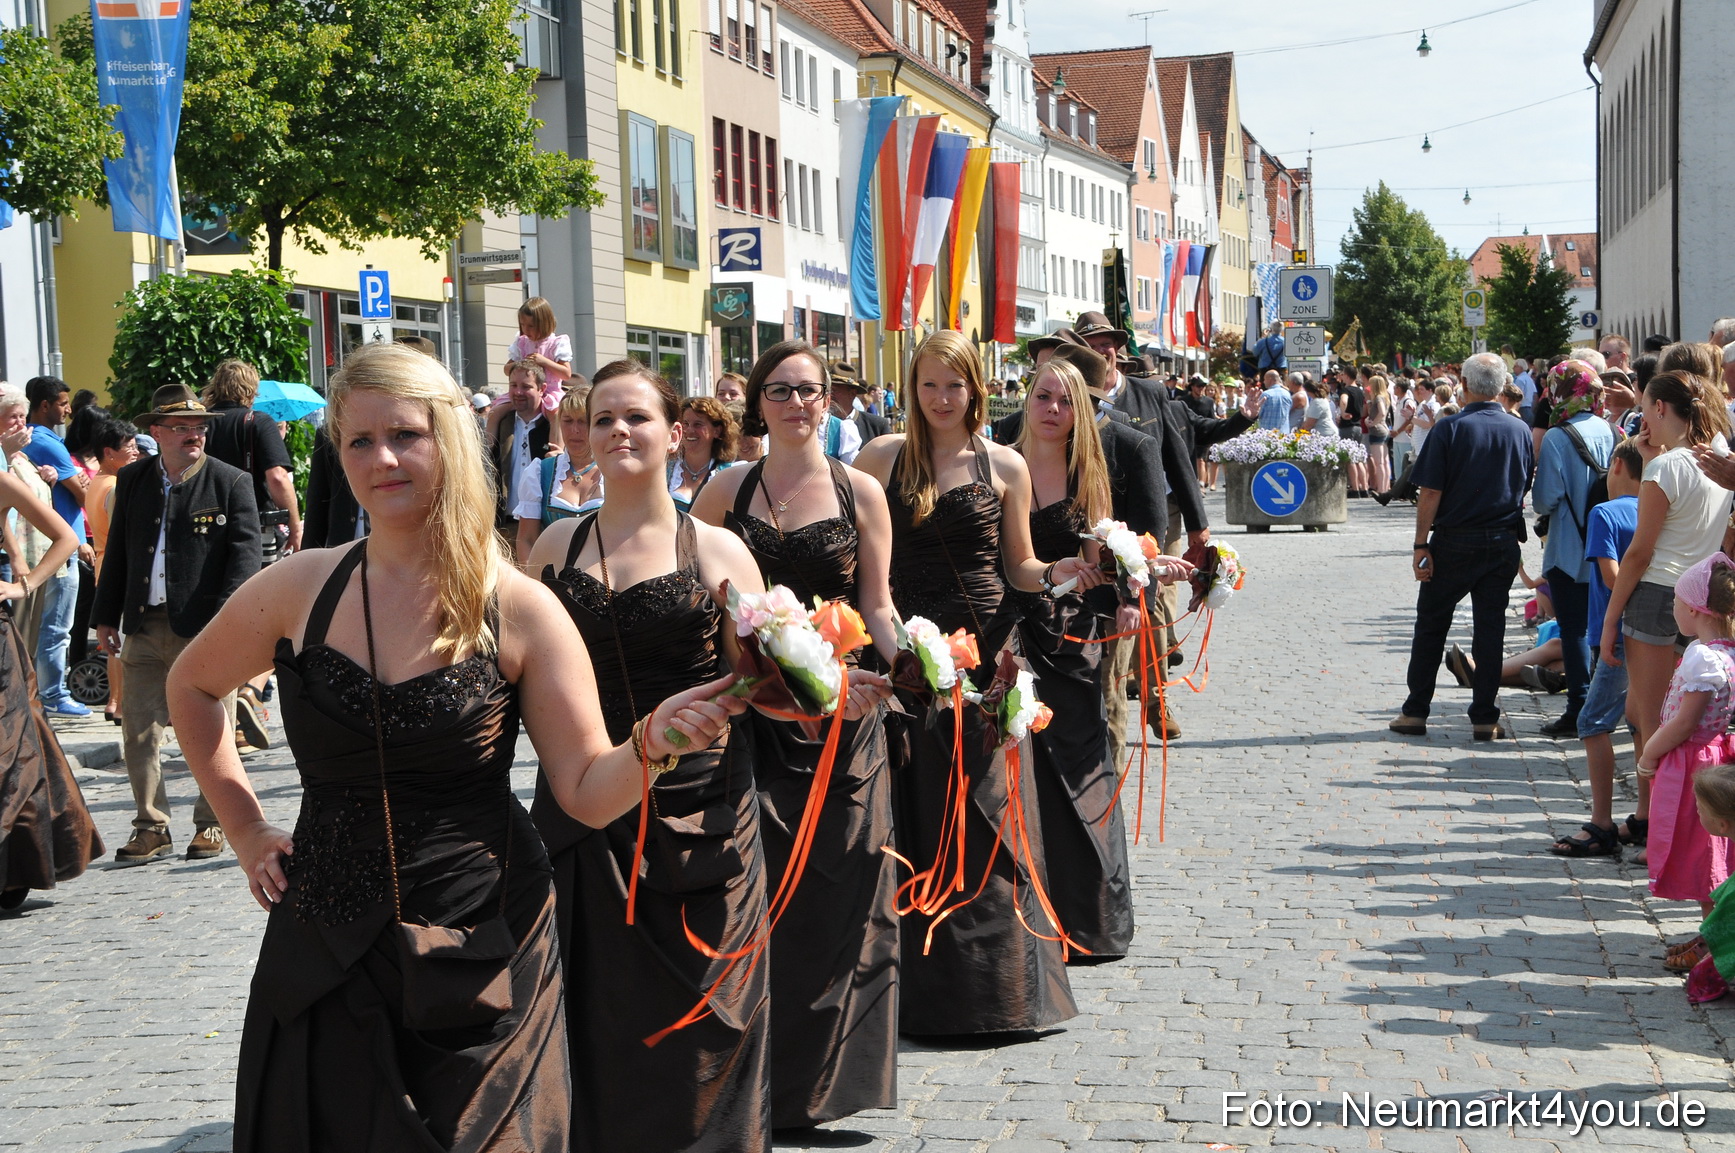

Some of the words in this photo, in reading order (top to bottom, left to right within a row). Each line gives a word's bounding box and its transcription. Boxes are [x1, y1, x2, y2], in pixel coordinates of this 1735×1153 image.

[460, 253, 519, 264] Brunnwirtsgasse
[1294, 250, 1306, 262] H
[366, 276, 384, 312] P
[724, 294, 738, 312] G2
[1292, 306, 1317, 314] ZONE
